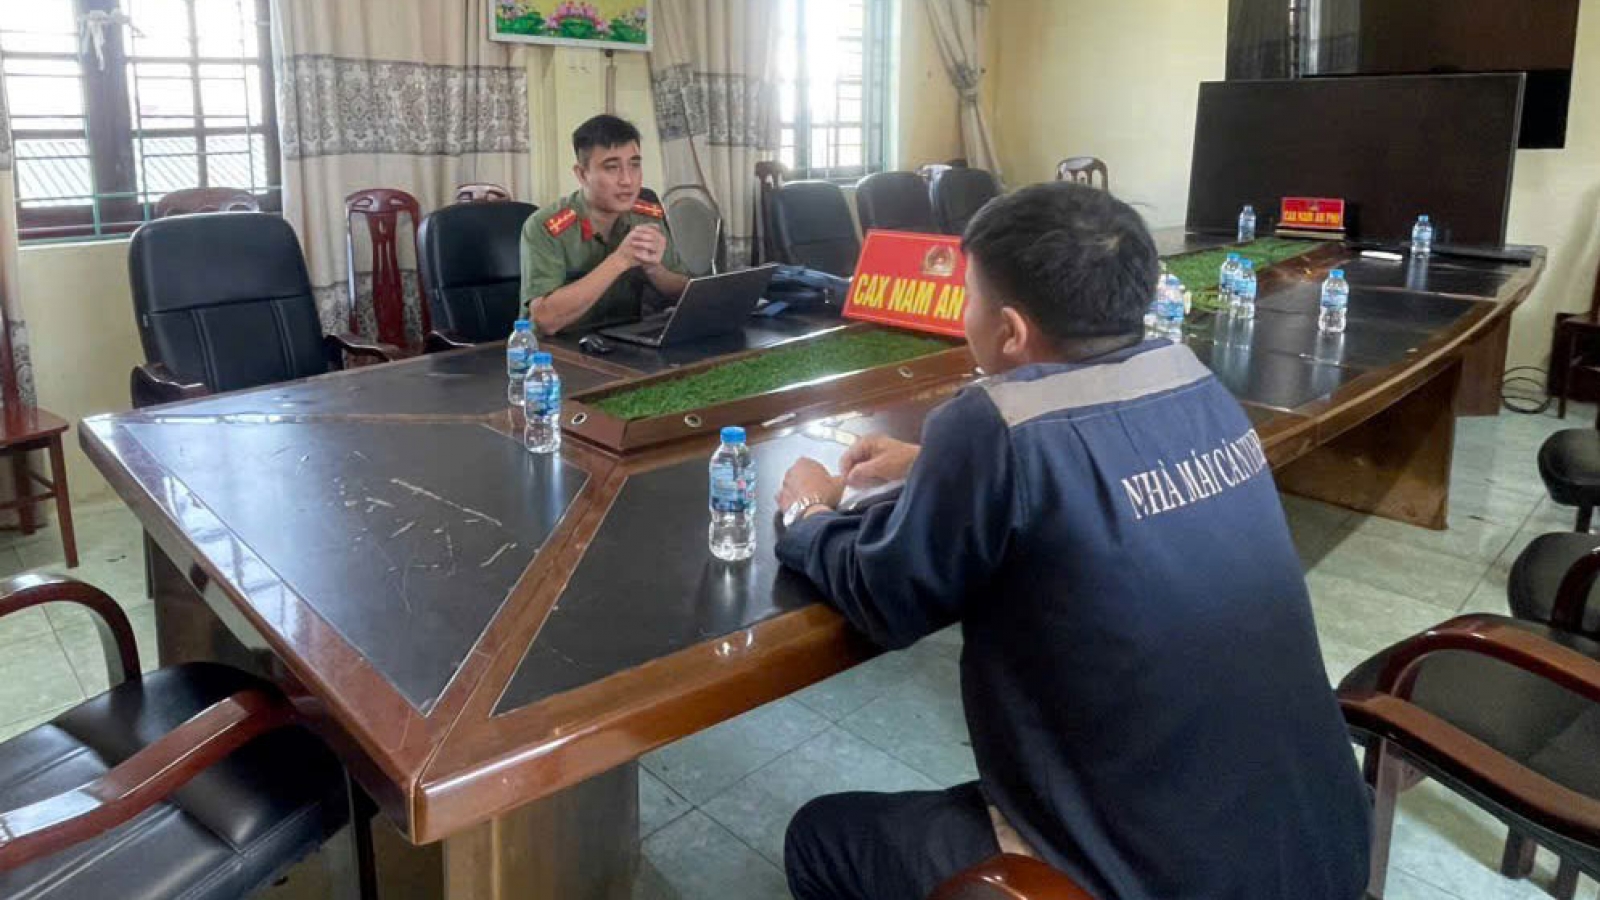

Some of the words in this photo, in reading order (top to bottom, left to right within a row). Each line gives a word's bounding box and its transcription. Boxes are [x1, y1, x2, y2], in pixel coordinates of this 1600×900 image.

[853, 273, 891, 309] CAX
[887, 278, 937, 316] NAM
[933, 283, 965, 320] AN
[1121, 458, 1187, 520] NHÀ
